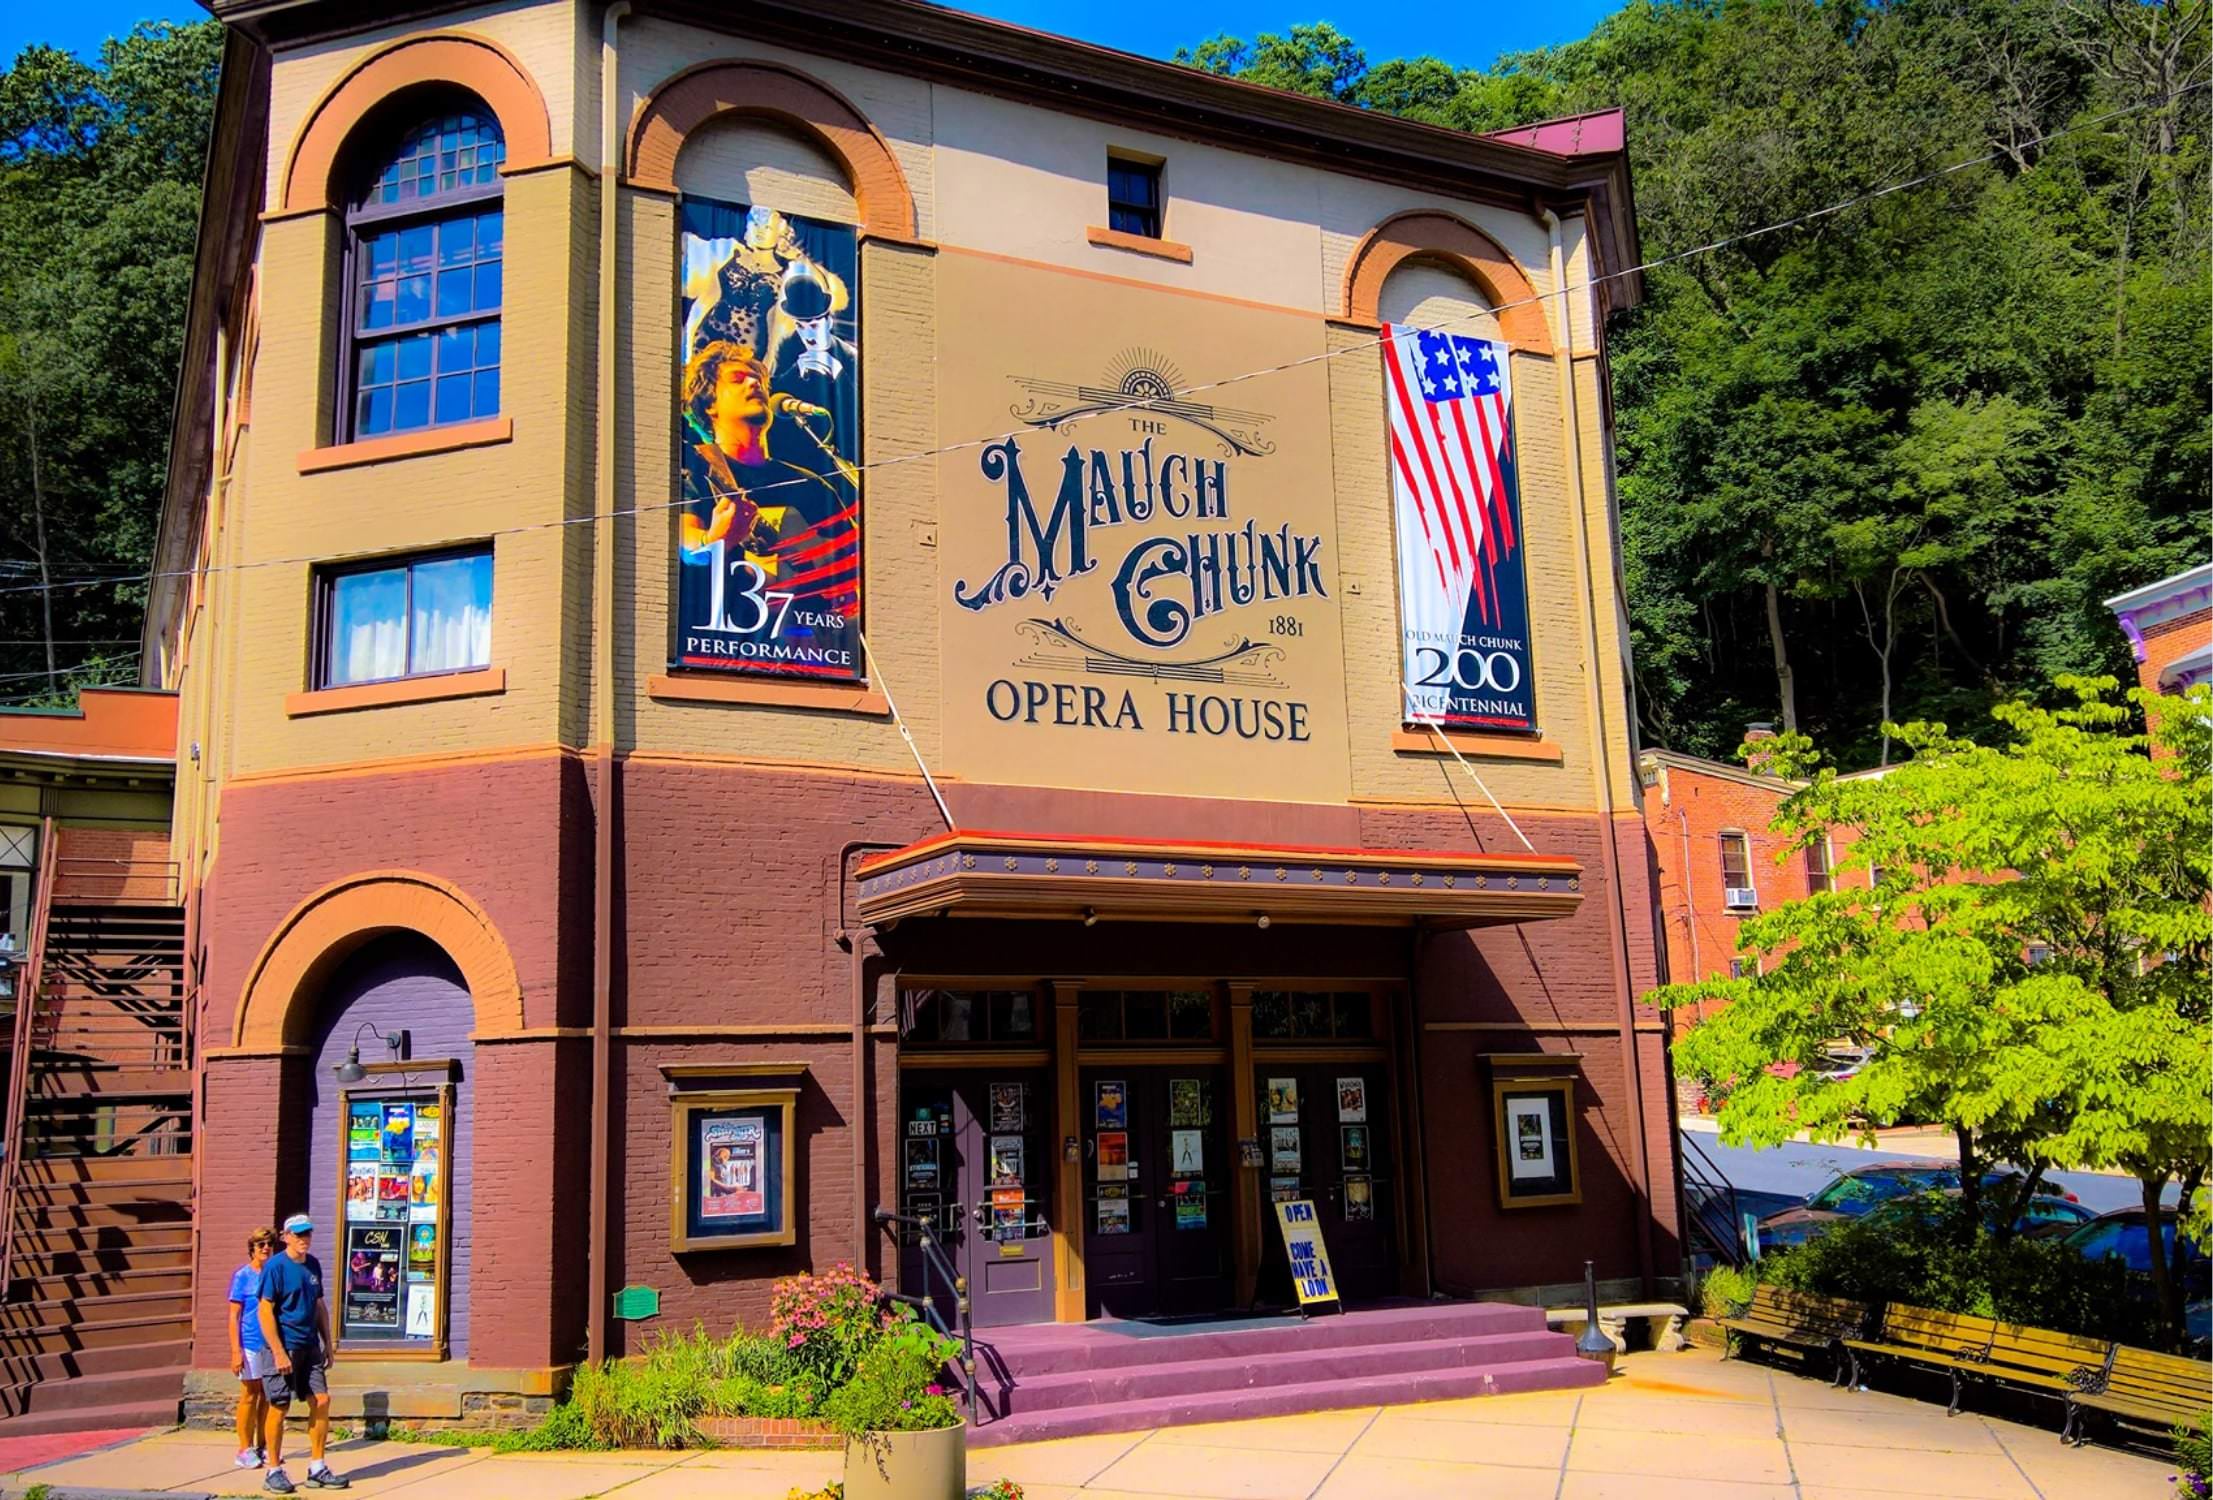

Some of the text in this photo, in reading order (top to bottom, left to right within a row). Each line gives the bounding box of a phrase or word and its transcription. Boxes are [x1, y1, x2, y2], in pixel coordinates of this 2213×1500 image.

[1128, 417, 1168, 436] THE
[954, 436, 1229, 612] MAUCH
[691, 539, 845, 640] 137 YEARS
[1110, 518, 1330, 648] CHUNK
[1268, 615, 1304, 637] 1881
[686, 637, 851, 665] PERFORMANCE
[1405, 629, 1522, 651] OLD MAUCH CHUNK
[1414, 647, 1520, 692] 200
[985, 679, 1312, 742] OPERA HOUSE
[1411, 694, 1527, 717] BICENTENNIAL
[909, 1121, 936, 1135] NEXT
[1284, 1203, 1313, 1222] OPEN
[364, 1230, 389, 1245] CSN
[1289, 1241, 1316, 1260] COME
[1291, 1259, 1328, 1279] HAVE A
[1301, 1278, 1330, 1298] LOOK
